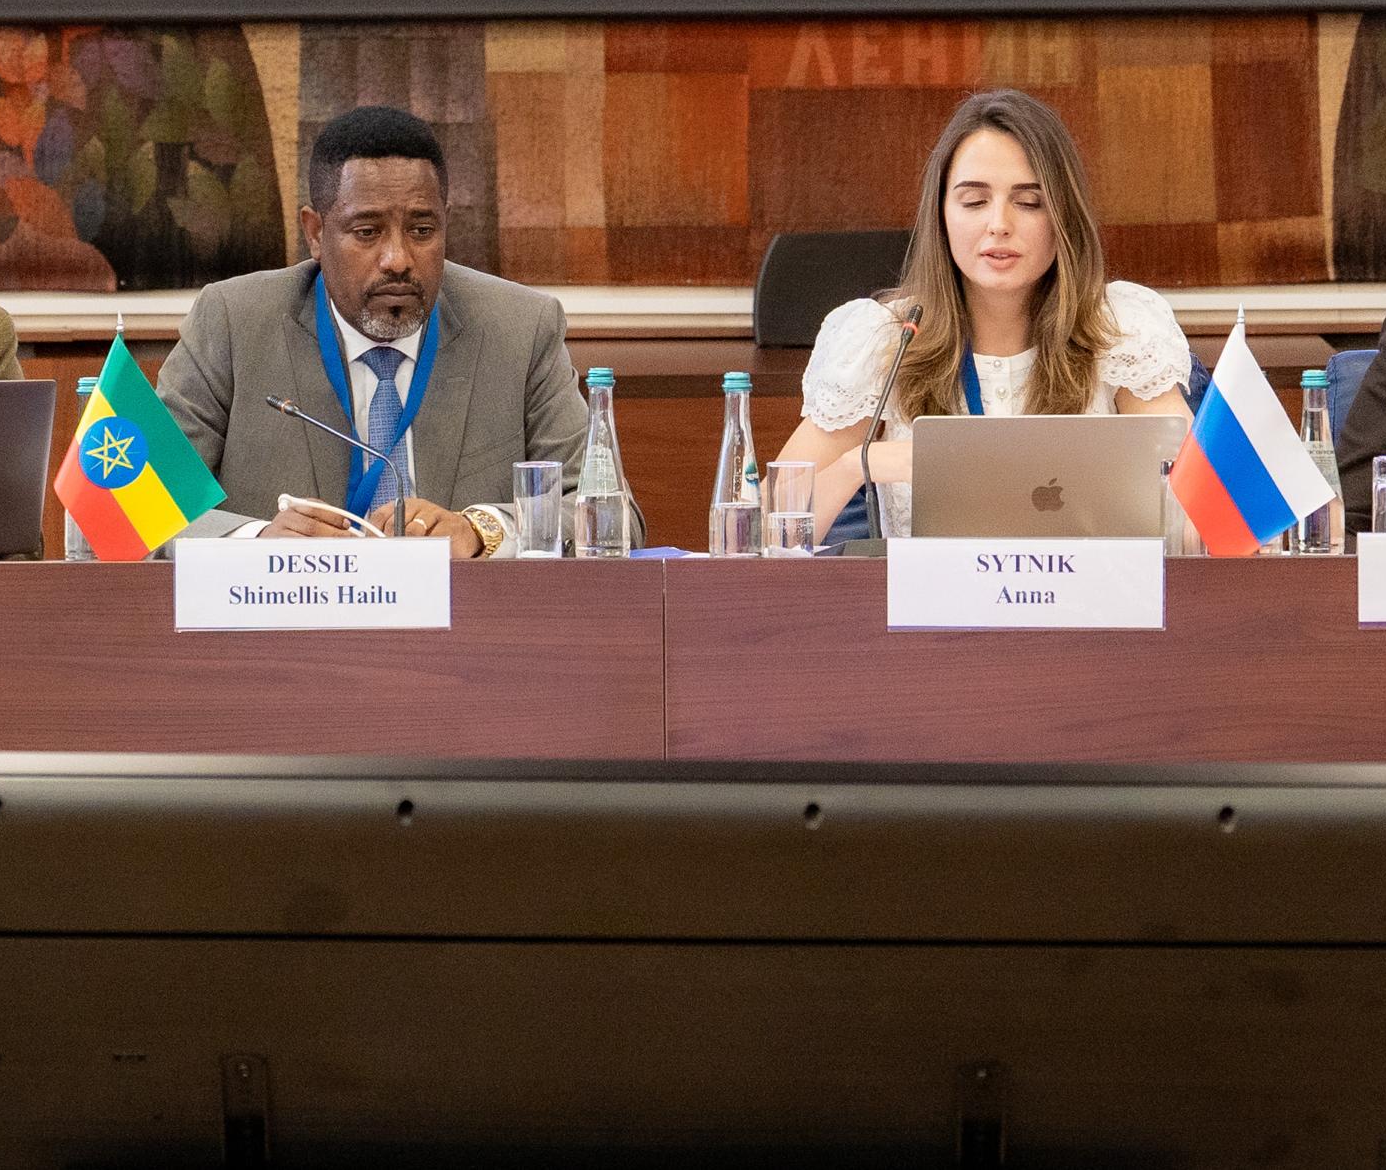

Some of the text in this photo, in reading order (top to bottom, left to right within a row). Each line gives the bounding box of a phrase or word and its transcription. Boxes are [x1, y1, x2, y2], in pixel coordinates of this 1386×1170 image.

[267, 554, 359, 574] DESSIE
[976, 553, 1076, 574] SYTNIK
[229, 585, 398, 606] Shimellis Hailu
[994, 586, 1056, 605] Anna
